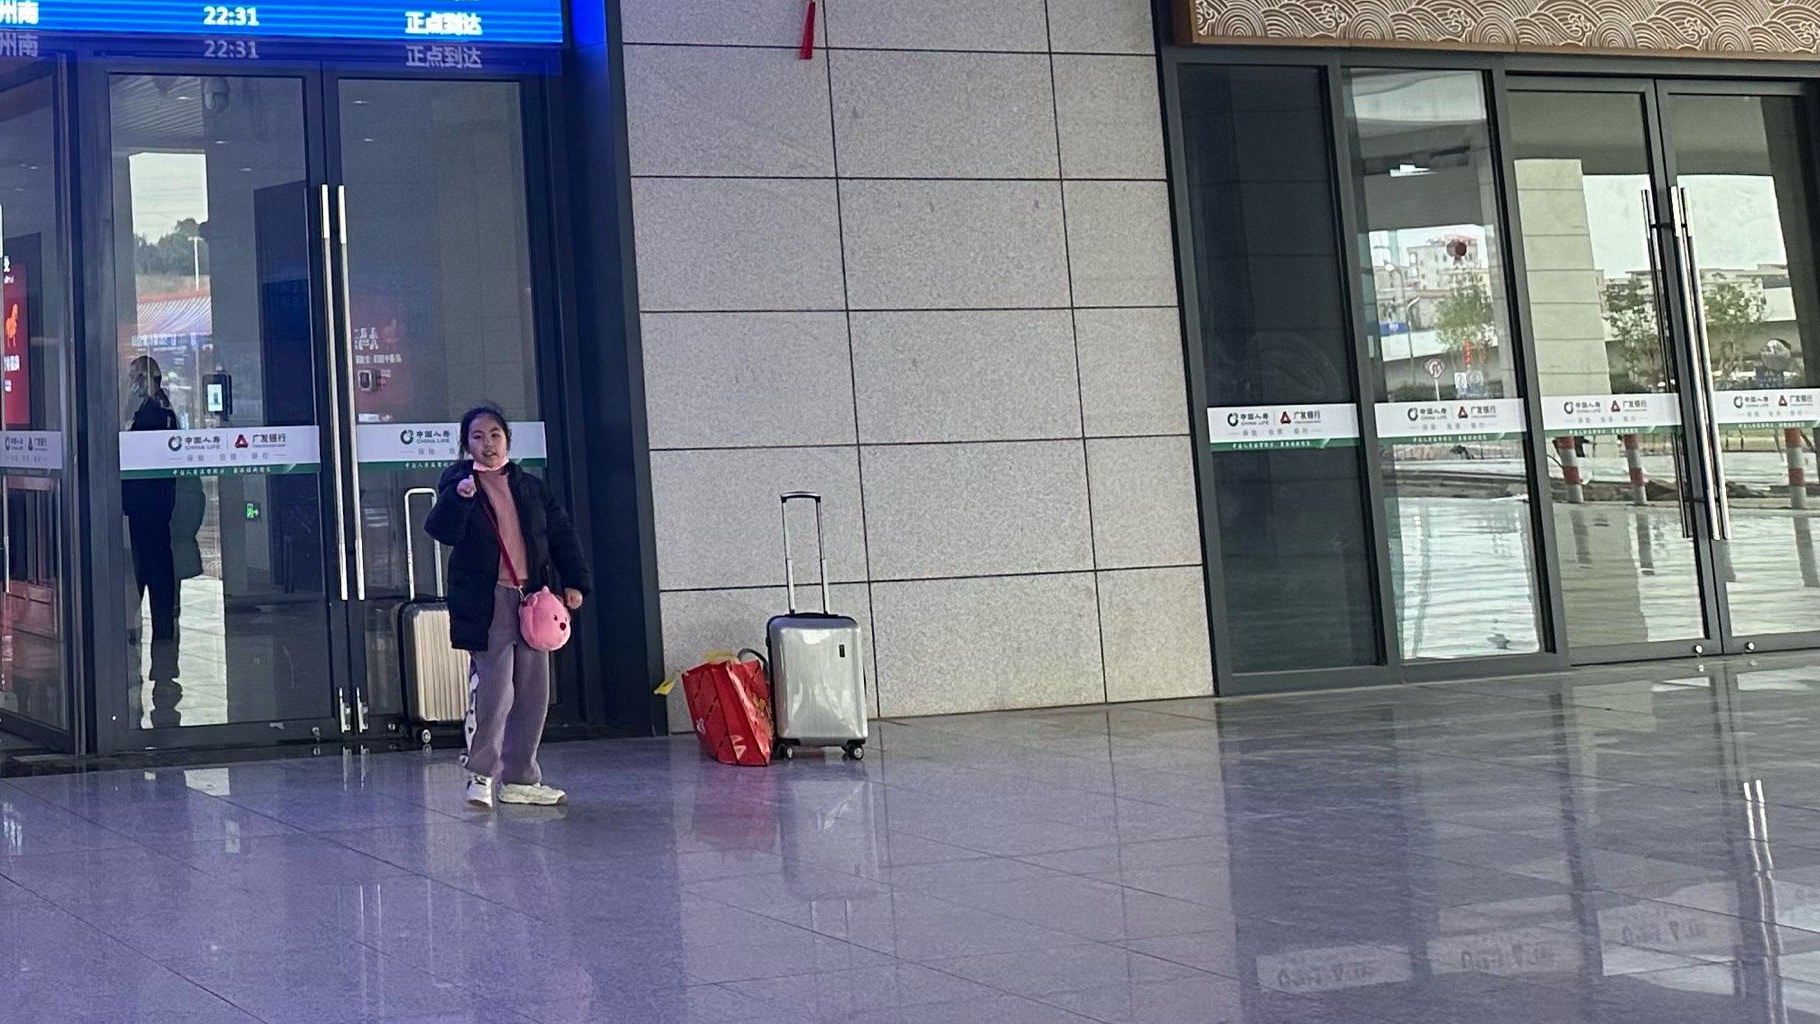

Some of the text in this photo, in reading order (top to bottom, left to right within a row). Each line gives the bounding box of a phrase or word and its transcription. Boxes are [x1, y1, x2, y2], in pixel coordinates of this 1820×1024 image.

[203, 6, 259, 27] 22:31
[405, 11, 482, 37] 正点到达
[204, 40, 259, 60] 22:31
[405, 43, 482, 69] 正点到达
[1293, 410, 1321, 419] 广发银行
[252, 433, 286, 443] 广发银行
[416, 430, 451, 438] 中国人寿
[185, 436, 221, 444] 中国人寿
